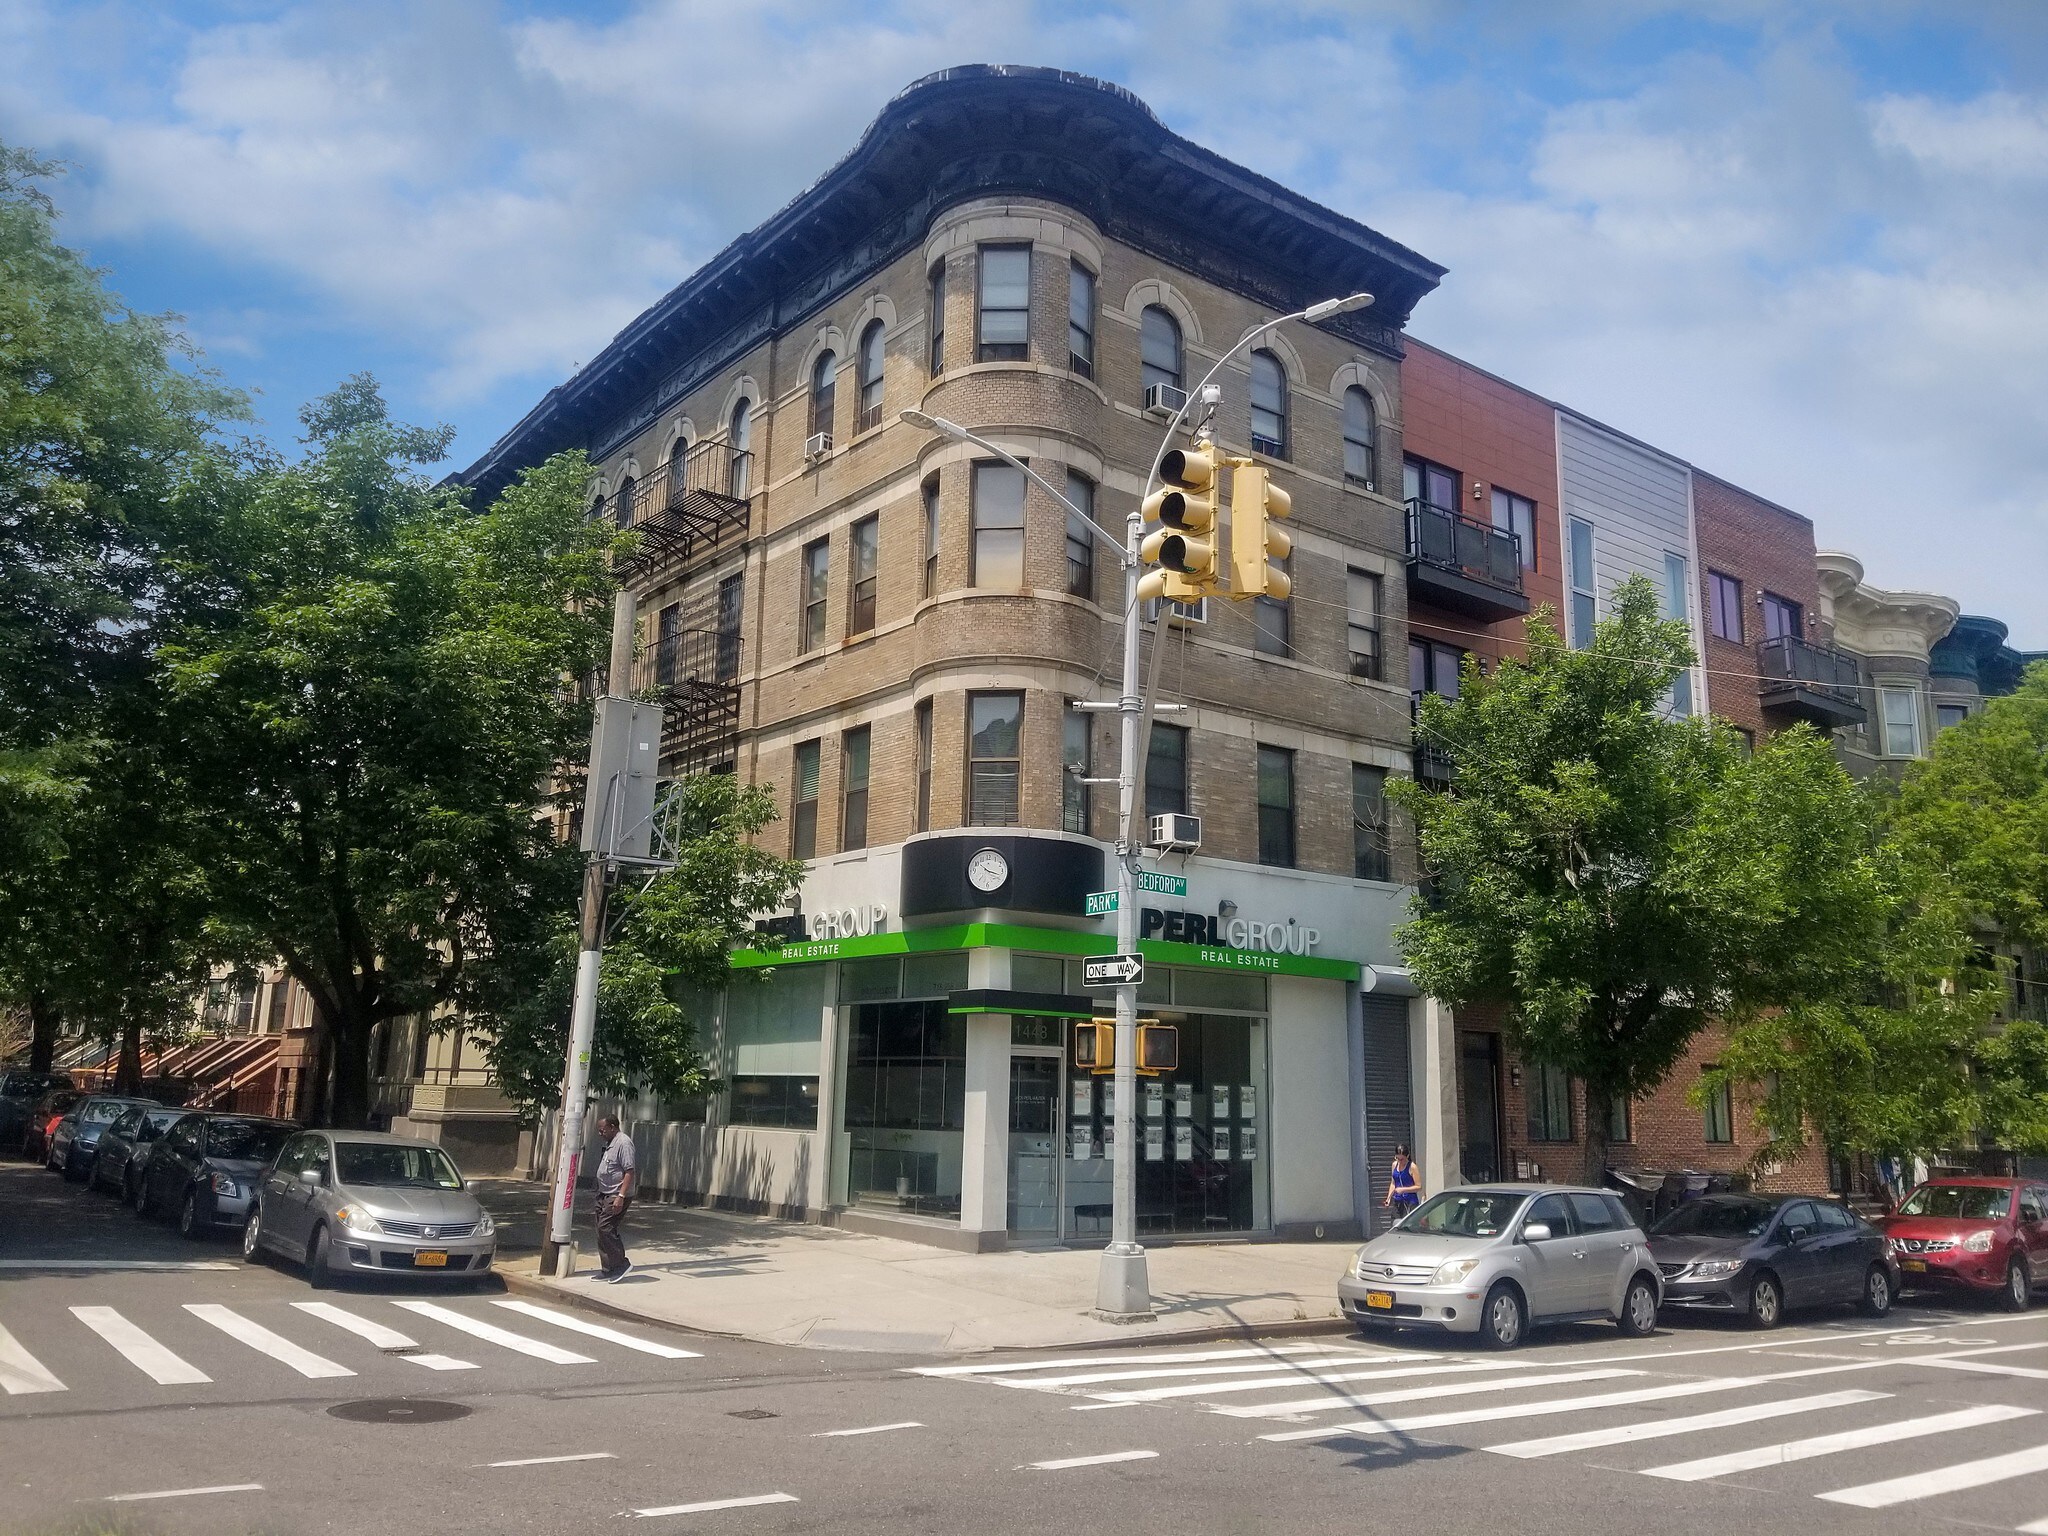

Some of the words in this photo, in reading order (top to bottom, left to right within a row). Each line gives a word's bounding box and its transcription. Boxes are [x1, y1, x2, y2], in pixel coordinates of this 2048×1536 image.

[1138, 872, 1176, 893] BEDFORD
[1175, 879, 1185, 888] AV
[1088, 895, 1111, 913] PARK
[1110, 893, 1118, 903] PL
[811, 903, 888, 942] GROUP
[1140, 907, 1227, 947] PERL
[1226, 918, 1321, 957] GROUP
[782, 947, 804, 959] REAL
[807, 943, 840, 957] ESTATE
[1201, 950, 1232, 963] REAL
[1237, 954, 1279, 968] ESTATE
[1088, 964, 1107, 977] ONE
[1116, 963, 1136, 975] WAY
